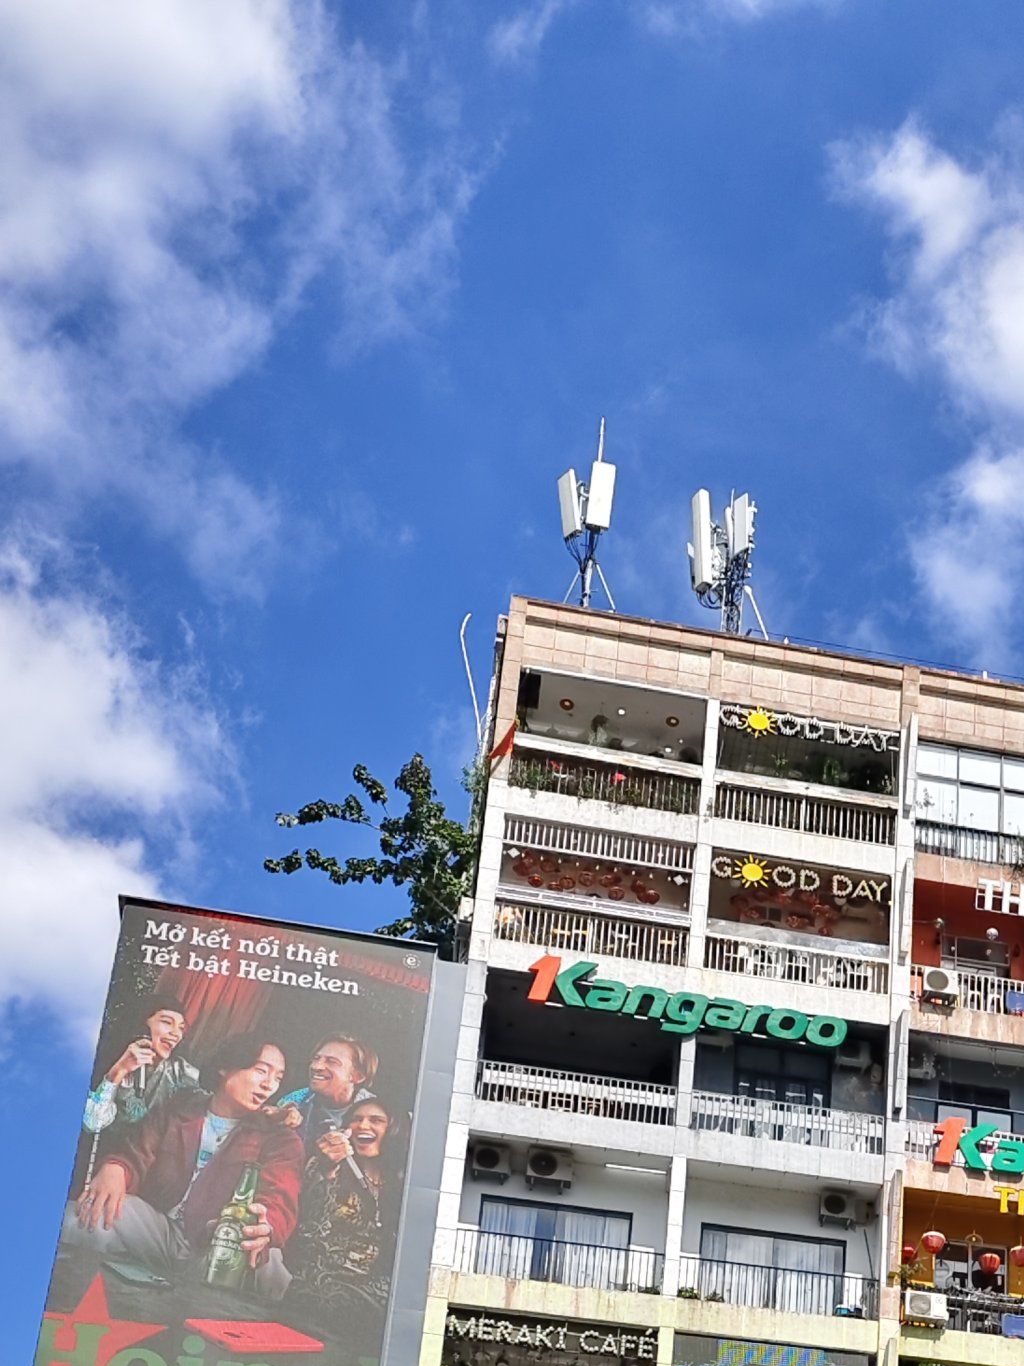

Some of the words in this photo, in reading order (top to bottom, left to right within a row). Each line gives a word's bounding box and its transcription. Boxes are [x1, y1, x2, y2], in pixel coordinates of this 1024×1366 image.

[832, 873, 888, 902] DAY
[144, 919, 187, 942] Mở
[191, 926, 230, 950] kết
[239, 935, 279, 958] nối
[286, 941, 339, 968] thật
[141, 944, 180, 968] Tết
[189, 953, 230, 979] bật
[239, 961, 360, 996] Heineken
[447, 1314, 568, 1351] MERAKI
[579, 1328, 658, 1360] CAFÉ
